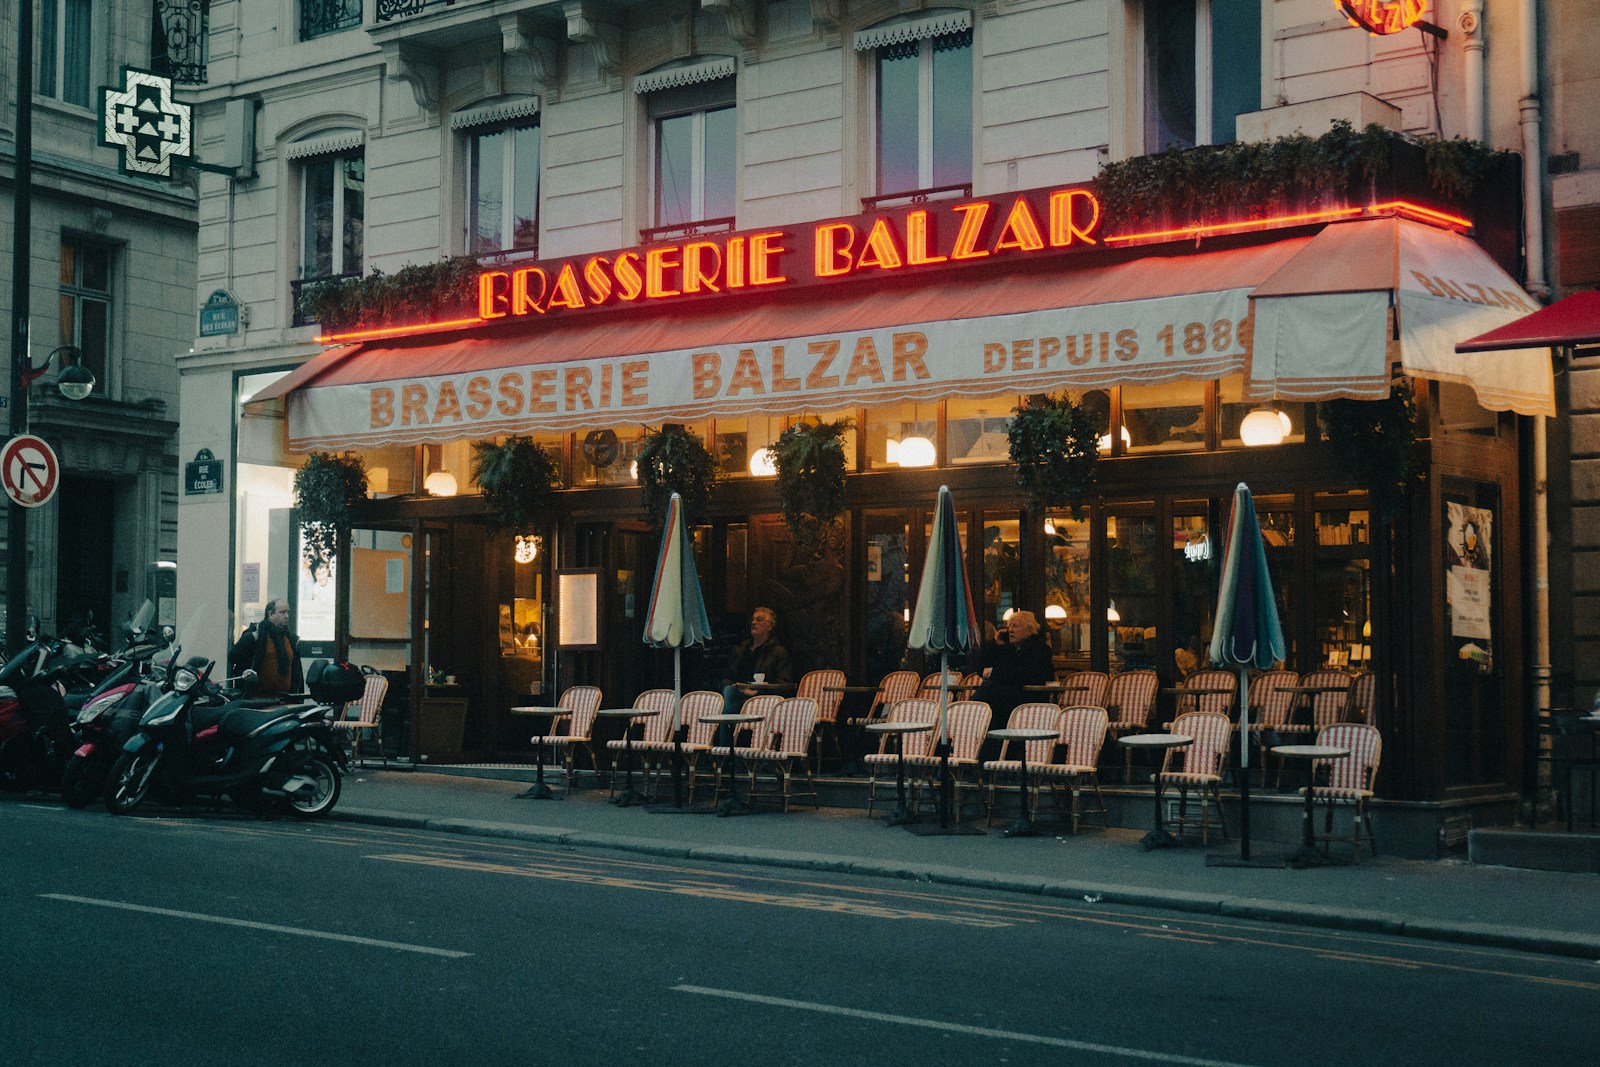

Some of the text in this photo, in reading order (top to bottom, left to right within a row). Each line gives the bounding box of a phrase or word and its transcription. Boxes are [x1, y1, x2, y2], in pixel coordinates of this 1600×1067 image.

[478, 188, 1101, 320] BRASSERIE BALZAR
[1410, 269, 1537, 313] BALZAR
[369, 360, 649, 429] BRASSERIE
[692, 331, 930, 400] BALZAR
[983, 328, 1140, 374] DEPUIS
[198, 465, 209, 474] RUE
